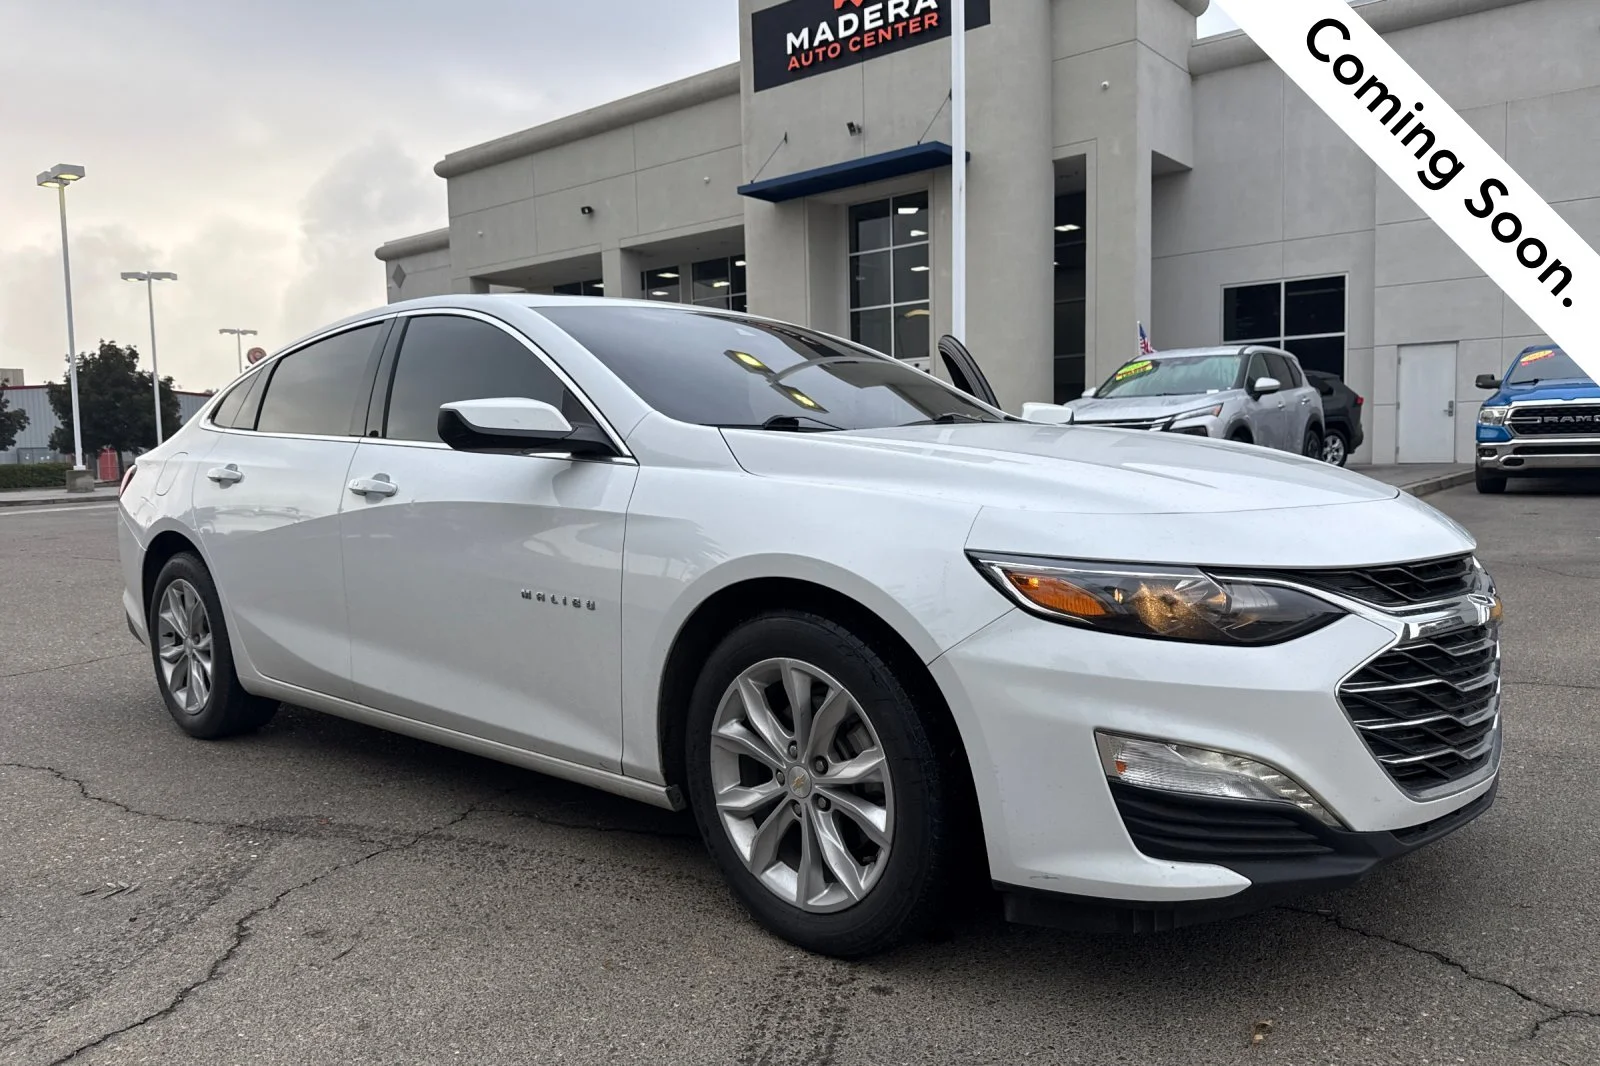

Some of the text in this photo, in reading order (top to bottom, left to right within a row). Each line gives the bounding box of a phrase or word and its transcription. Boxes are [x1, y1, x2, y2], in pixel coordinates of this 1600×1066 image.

[786, 0, 938, 55] MADERA
[787, 12, 939, 71] AUTO CENTER
[1543, 415, 1592, 423] RAM
[520, 588, 596, 611] MALIBU
